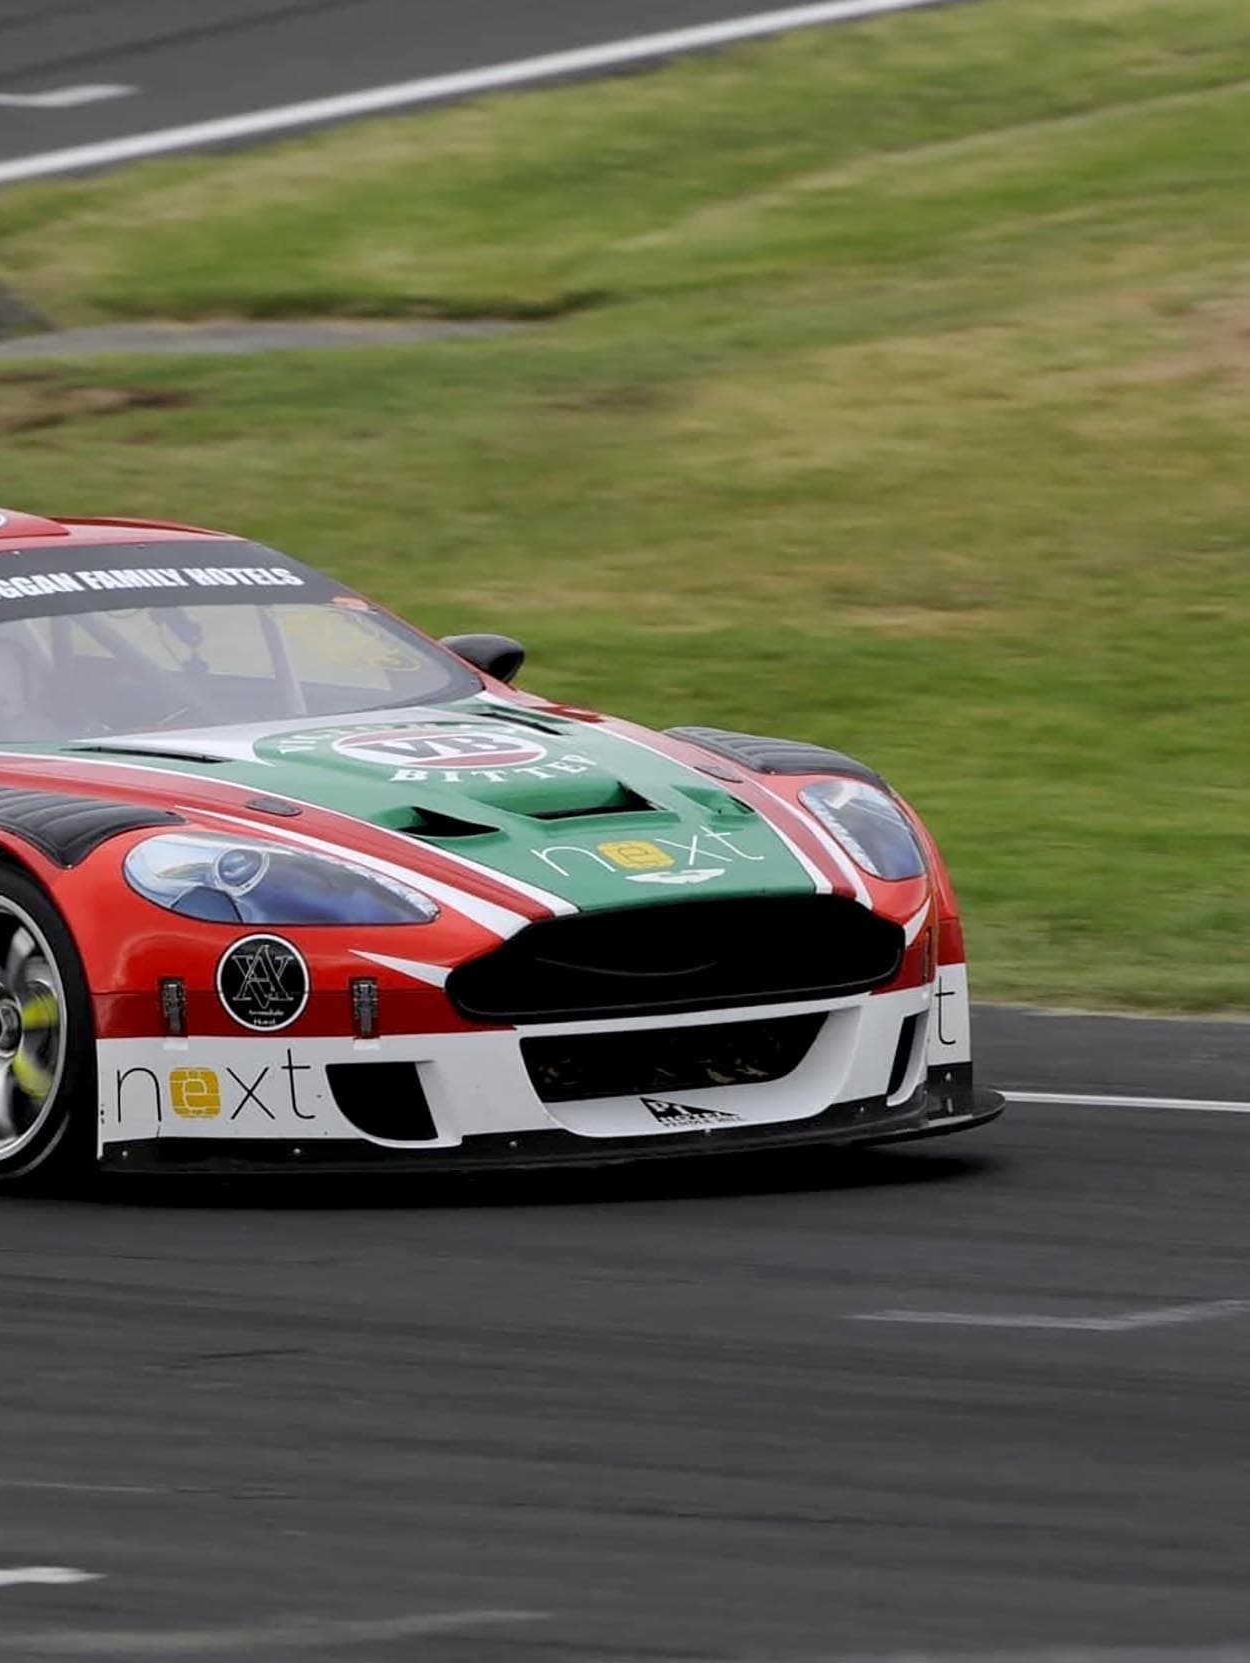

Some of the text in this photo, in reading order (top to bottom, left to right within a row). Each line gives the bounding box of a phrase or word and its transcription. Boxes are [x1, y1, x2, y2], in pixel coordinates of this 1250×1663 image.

[74, 568, 190, 590] FAMILY
[181, 567, 306, 587] HOTELS
[344, 735, 524, 759] VB
[116, 1048, 316, 1123] next
